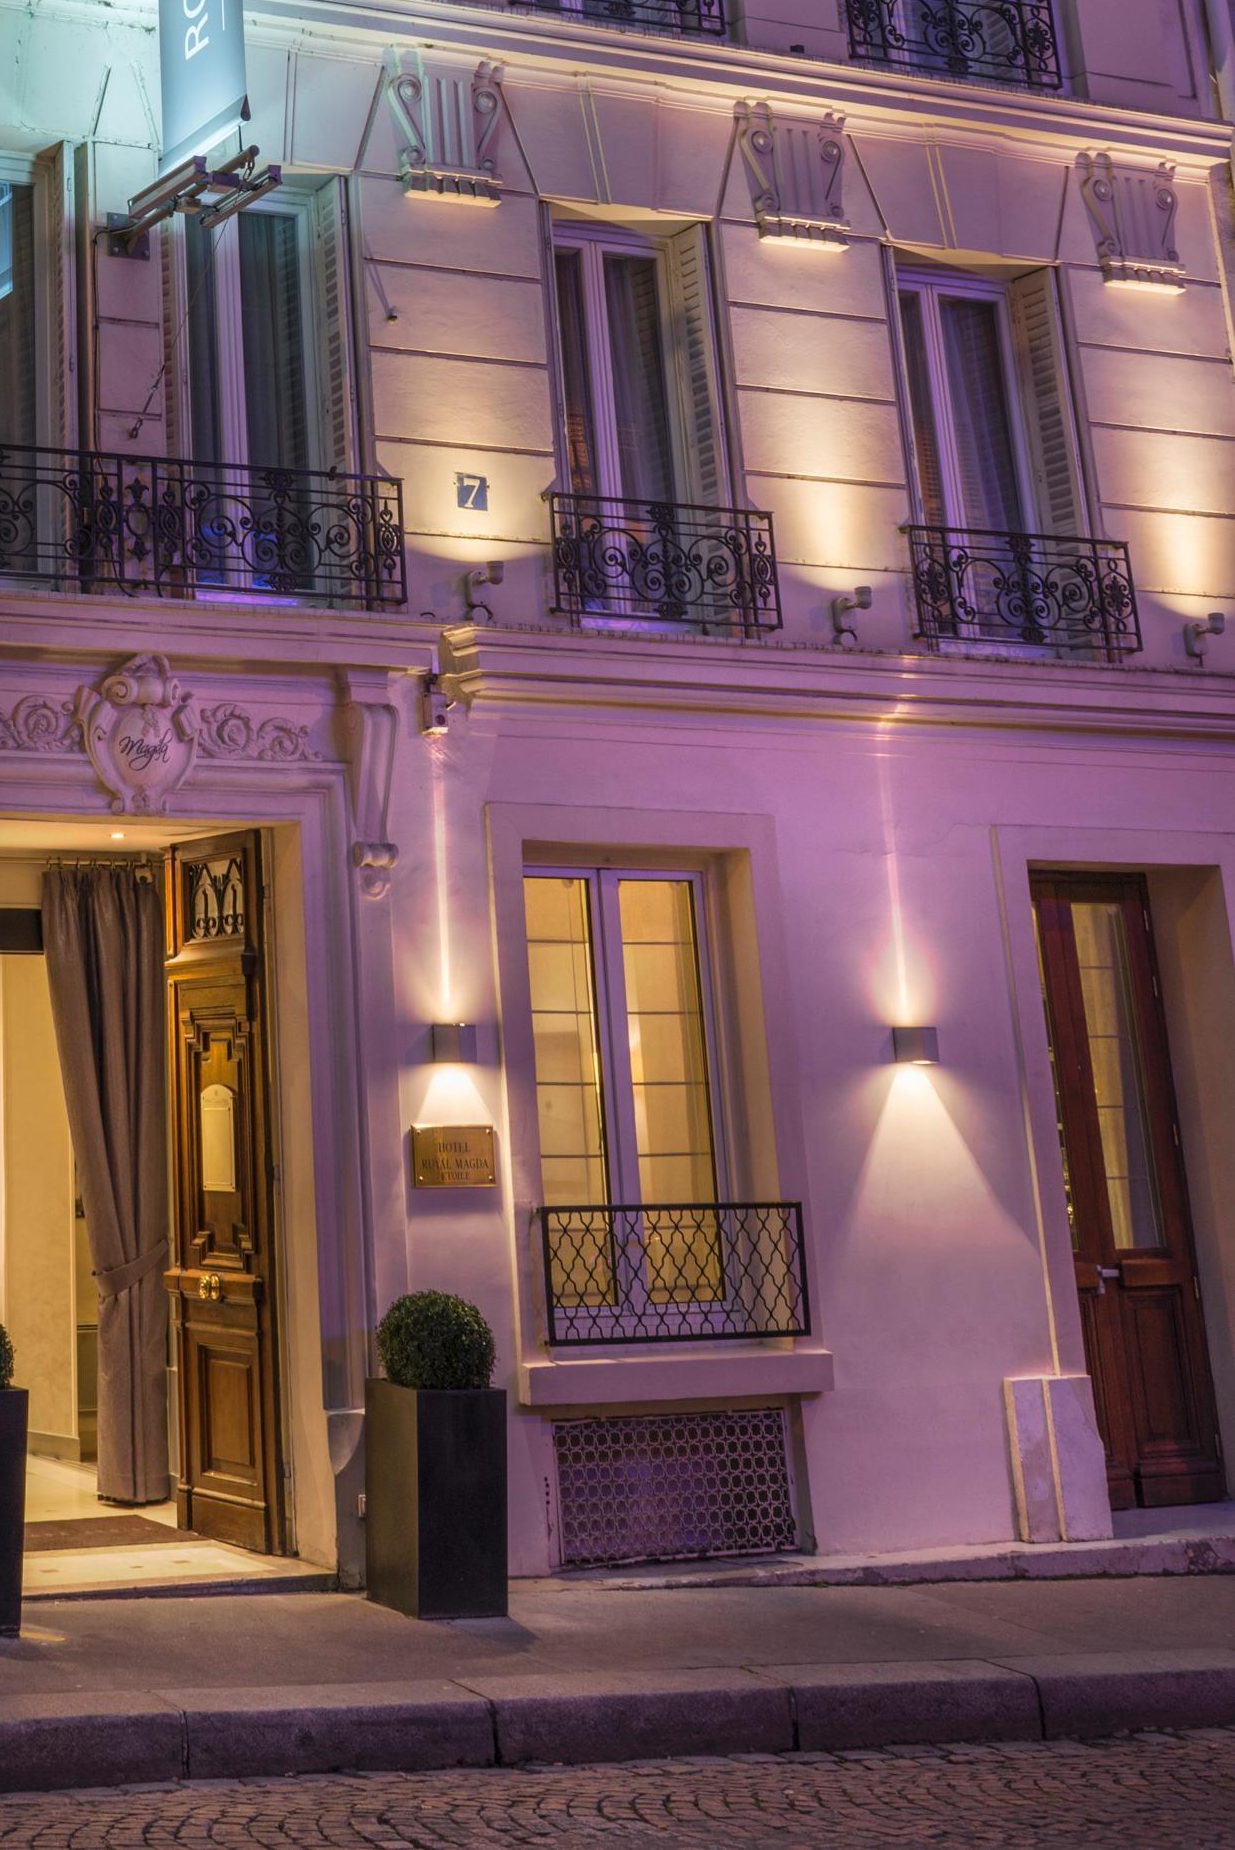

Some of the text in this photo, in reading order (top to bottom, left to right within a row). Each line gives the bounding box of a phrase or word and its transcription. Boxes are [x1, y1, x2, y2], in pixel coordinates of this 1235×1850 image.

[463, 477, 480, 508] 7
[118, 727, 174, 771] Magda
[438, 1141, 471, 1153] HOTEL
[421, 1157, 489, 1169] ROYAL MAGDA
